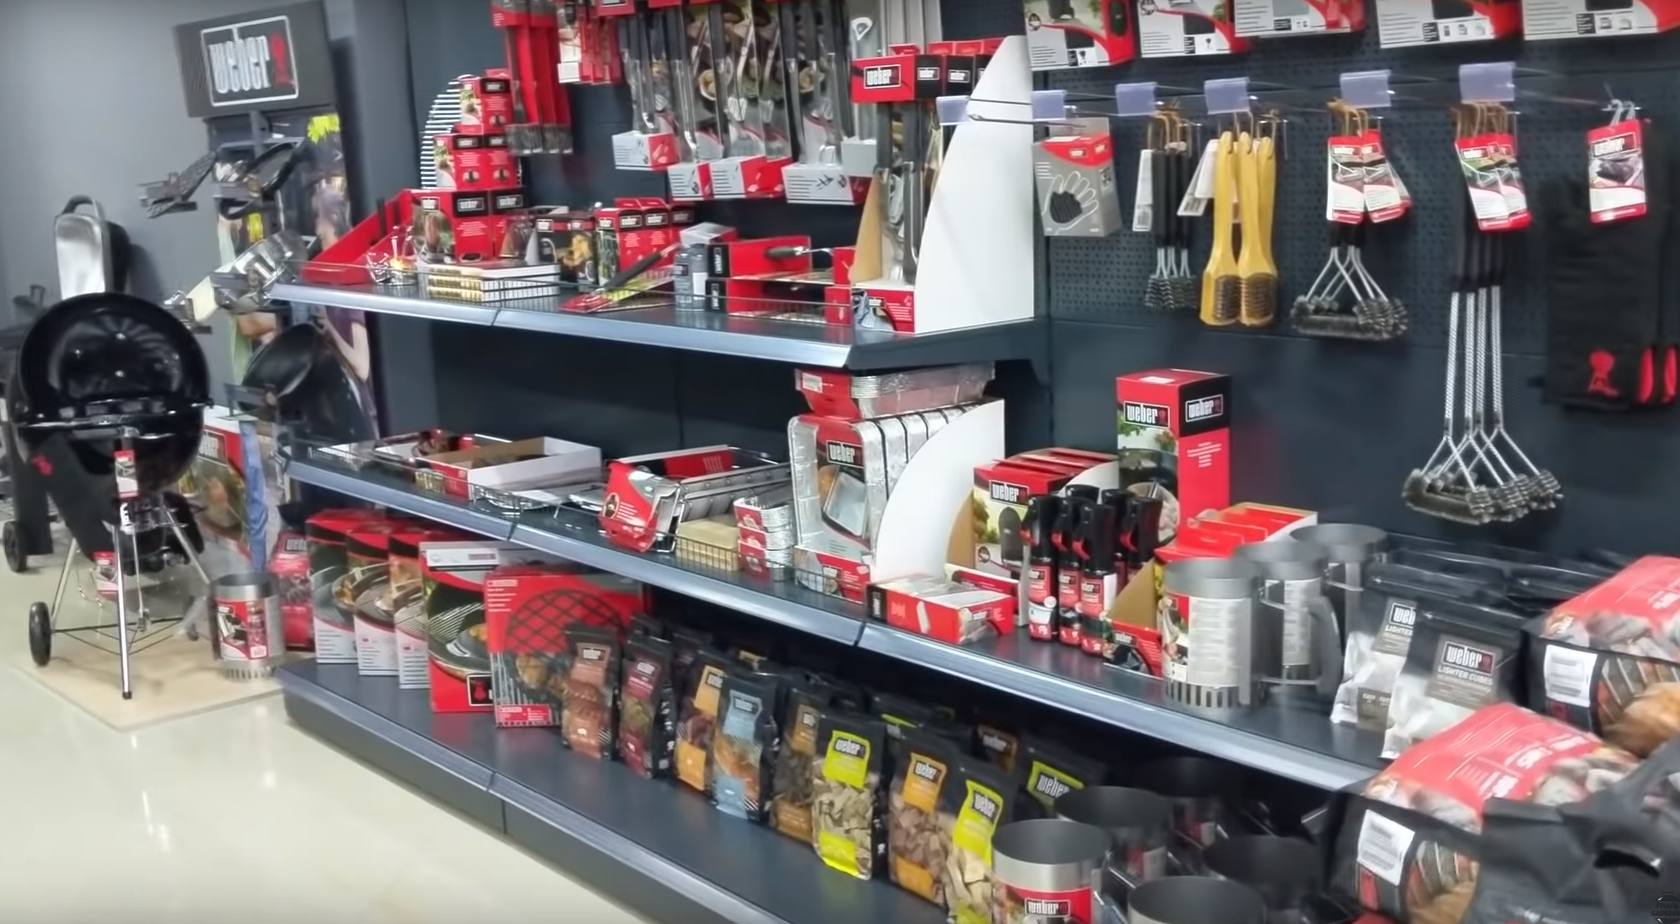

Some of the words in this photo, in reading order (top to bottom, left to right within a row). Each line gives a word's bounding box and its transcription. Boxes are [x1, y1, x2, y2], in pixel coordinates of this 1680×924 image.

[208, 27, 271, 94] weber
[867, 66, 892, 86] weber
[1126, 403, 1158, 424] weber
[1188, 399, 1214, 418] weber
[829, 442, 856, 463] weber
[992, 483, 1020, 502] weber
[1393, 607, 1416, 625] web
[1446, 645, 1483, 670] weber
[1438, 666, 1468, 679] LIGHTER
[1469, 672, 1493, 686] CUBES
[835, 738, 861, 756] weber
[915, 761, 937, 780] weber
[1037, 774, 1070, 798] weber
[974, 792, 996, 818] weber
[1028, 900, 1059, 915] weber
